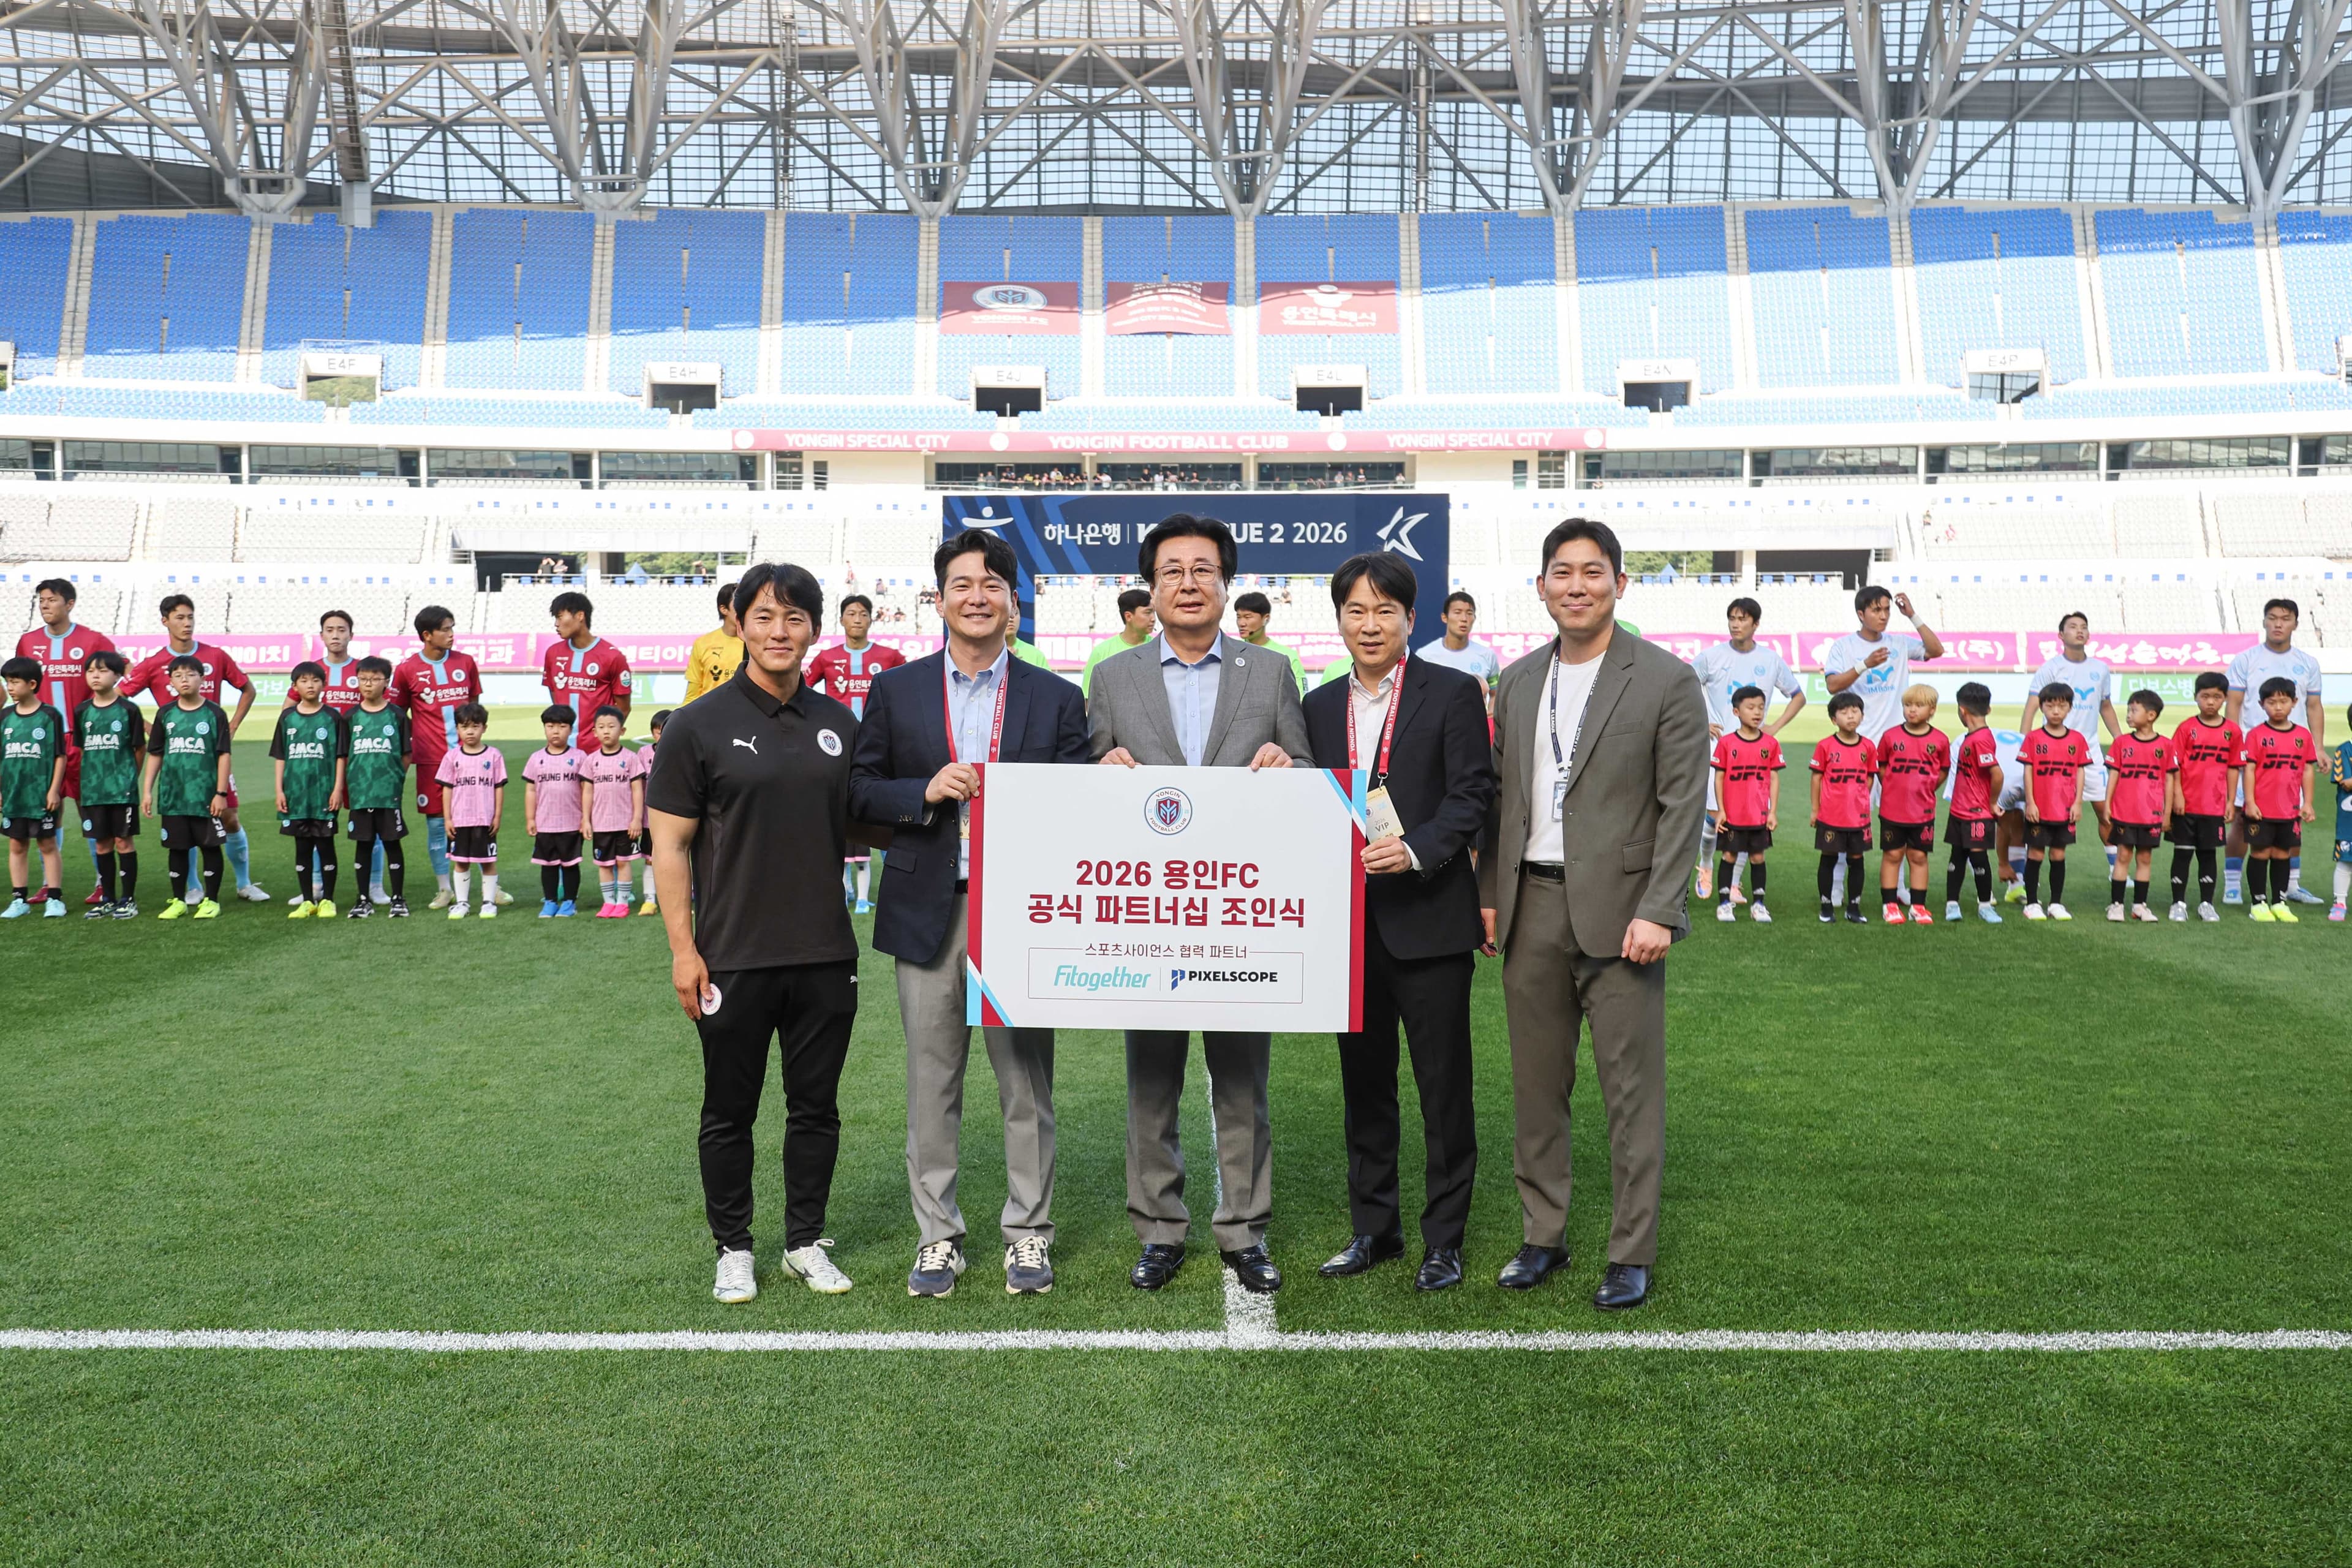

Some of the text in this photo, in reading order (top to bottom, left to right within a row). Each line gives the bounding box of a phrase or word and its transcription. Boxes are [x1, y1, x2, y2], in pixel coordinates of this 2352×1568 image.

[1280, 306, 1377, 322] 용인특례시
[328, 358, 356, 370] E4F
[1989, 355, 2018, 367] E4P
[669, 367, 697, 378] E4H
[997, 371, 1021, 382] E4J
[1317, 369, 1342, 381] E4L
[784, 433, 950, 448] YONGIN SPECIAL CITY
[1049, 435, 1289, 449] YONGIN FOOTBALL CLUB
[1387, 432, 1553, 448] YONGIN SPECIAL CITY
[1044, 522, 1121, 545] 하나은행
[1269, 523, 1284, 543] 2
[1292, 522, 1348, 543] 2026
[849, 679, 872, 689] 용인특
[1393, 665, 1404, 689] YONGIN
[2128, 677, 2194, 699] 다보스병
[995, 689, 1004, 722] FOOTBALL
[1388, 689, 1400, 723] FOOTBALL
[85, 734, 120, 747] SMCA
[353, 737, 392, 750] SMCA
[1893, 741, 1905, 752] 66
[2262, 738, 2274, 747] 44
[5, 742, 41, 755] SMCA
[289, 742, 324, 755] SMCA
[2035, 744, 2048, 754] 88
[2189, 745, 2230, 763] JFC
[1891, 758, 1933, 775] JFC
[2037, 761, 2075, 777] JFC
[2263, 754, 2302, 770] JFC
[538, 774, 561, 783] CHUNG
[1729, 766, 1768, 781] JFC
[1830, 769, 1866, 783] JFC
[2120, 764, 2160, 780] JFC
[1150, 817, 1187, 832] FOOTBALL CLUB
[1375, 821, 1389, 832] VIP
[1970, 822, 1985, 838] 18
[487, 843, 497, 856] 12
[1076, 859, 1260, 890] 2026 용인FC
[1028, 894, 1305, 928] 공식 파트너십 조인식
[1085, 942, 1248, 959] 스포츠사이언스 협력 파트너
[1054, 964, 1278, 991] Fitogether PIXELSCOPE
